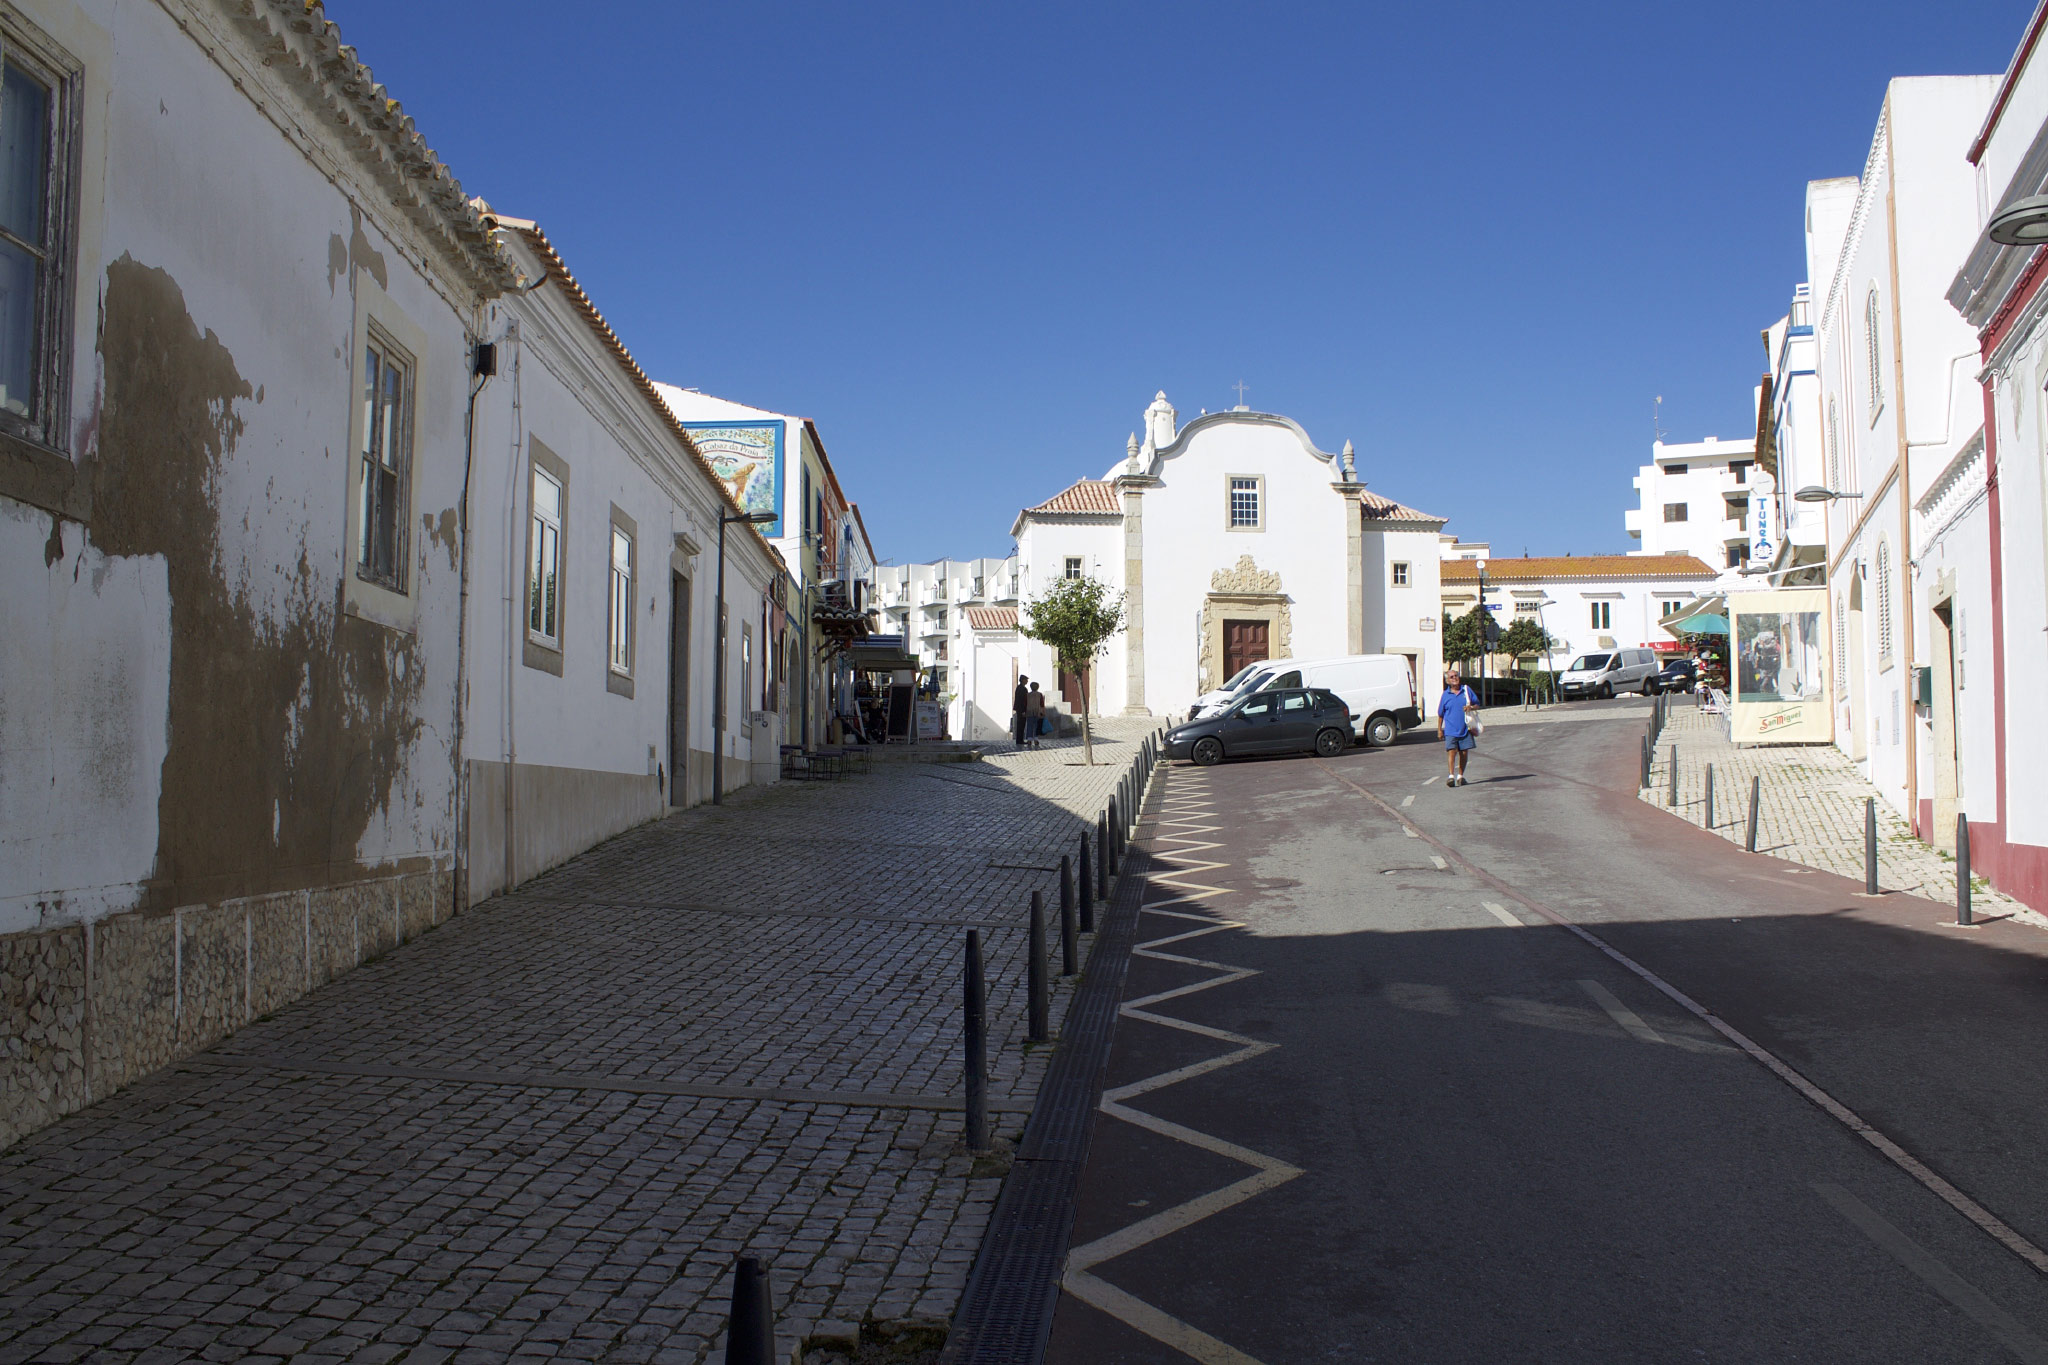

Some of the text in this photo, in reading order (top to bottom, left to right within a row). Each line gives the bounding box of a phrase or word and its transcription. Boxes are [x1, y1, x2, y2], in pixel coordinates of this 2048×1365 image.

[729, 443, 738, 451] da
[741, 444, 758, 456] Praia
[1774, 711, 1801, 725] Miguel
